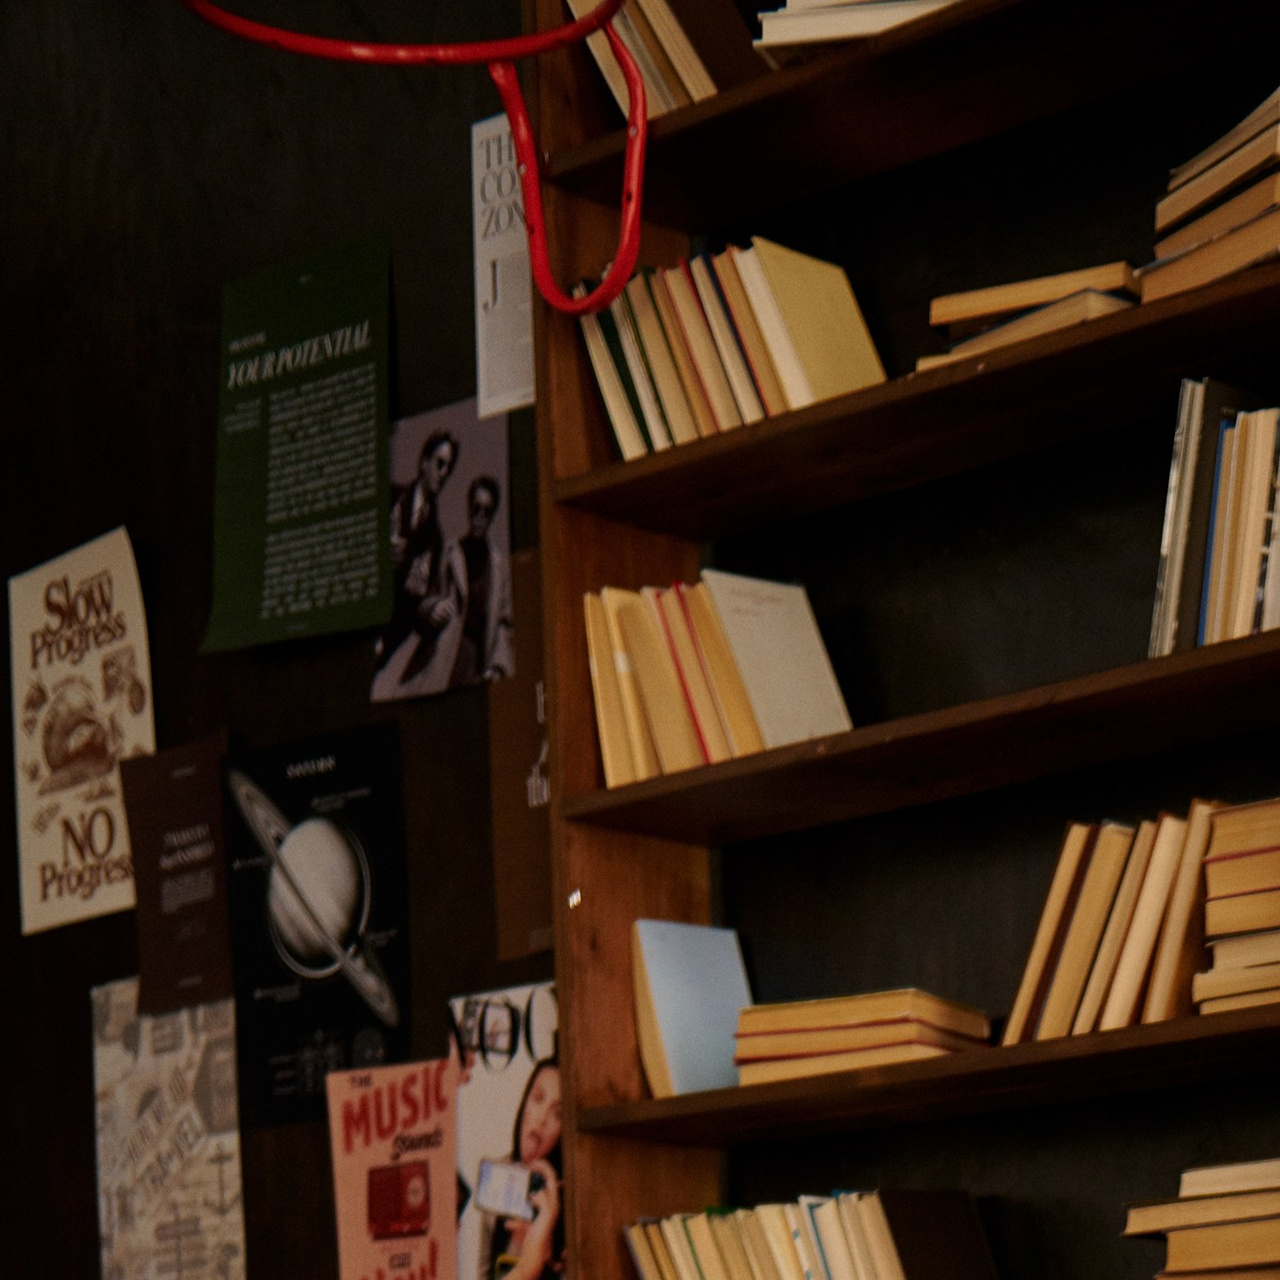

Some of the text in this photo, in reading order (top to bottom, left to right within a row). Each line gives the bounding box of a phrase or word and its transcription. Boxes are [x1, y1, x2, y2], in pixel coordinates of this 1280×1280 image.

[227, 351, 276, 391] YOUR
[274, 318, 373, 377] POTENTIAL
[44, 568, 114, 636] Slow
[30, 609, 127, 671] Progress
[60, 807, 114, 869] NO
[343, 1057, 448, 1155] MUSIC
